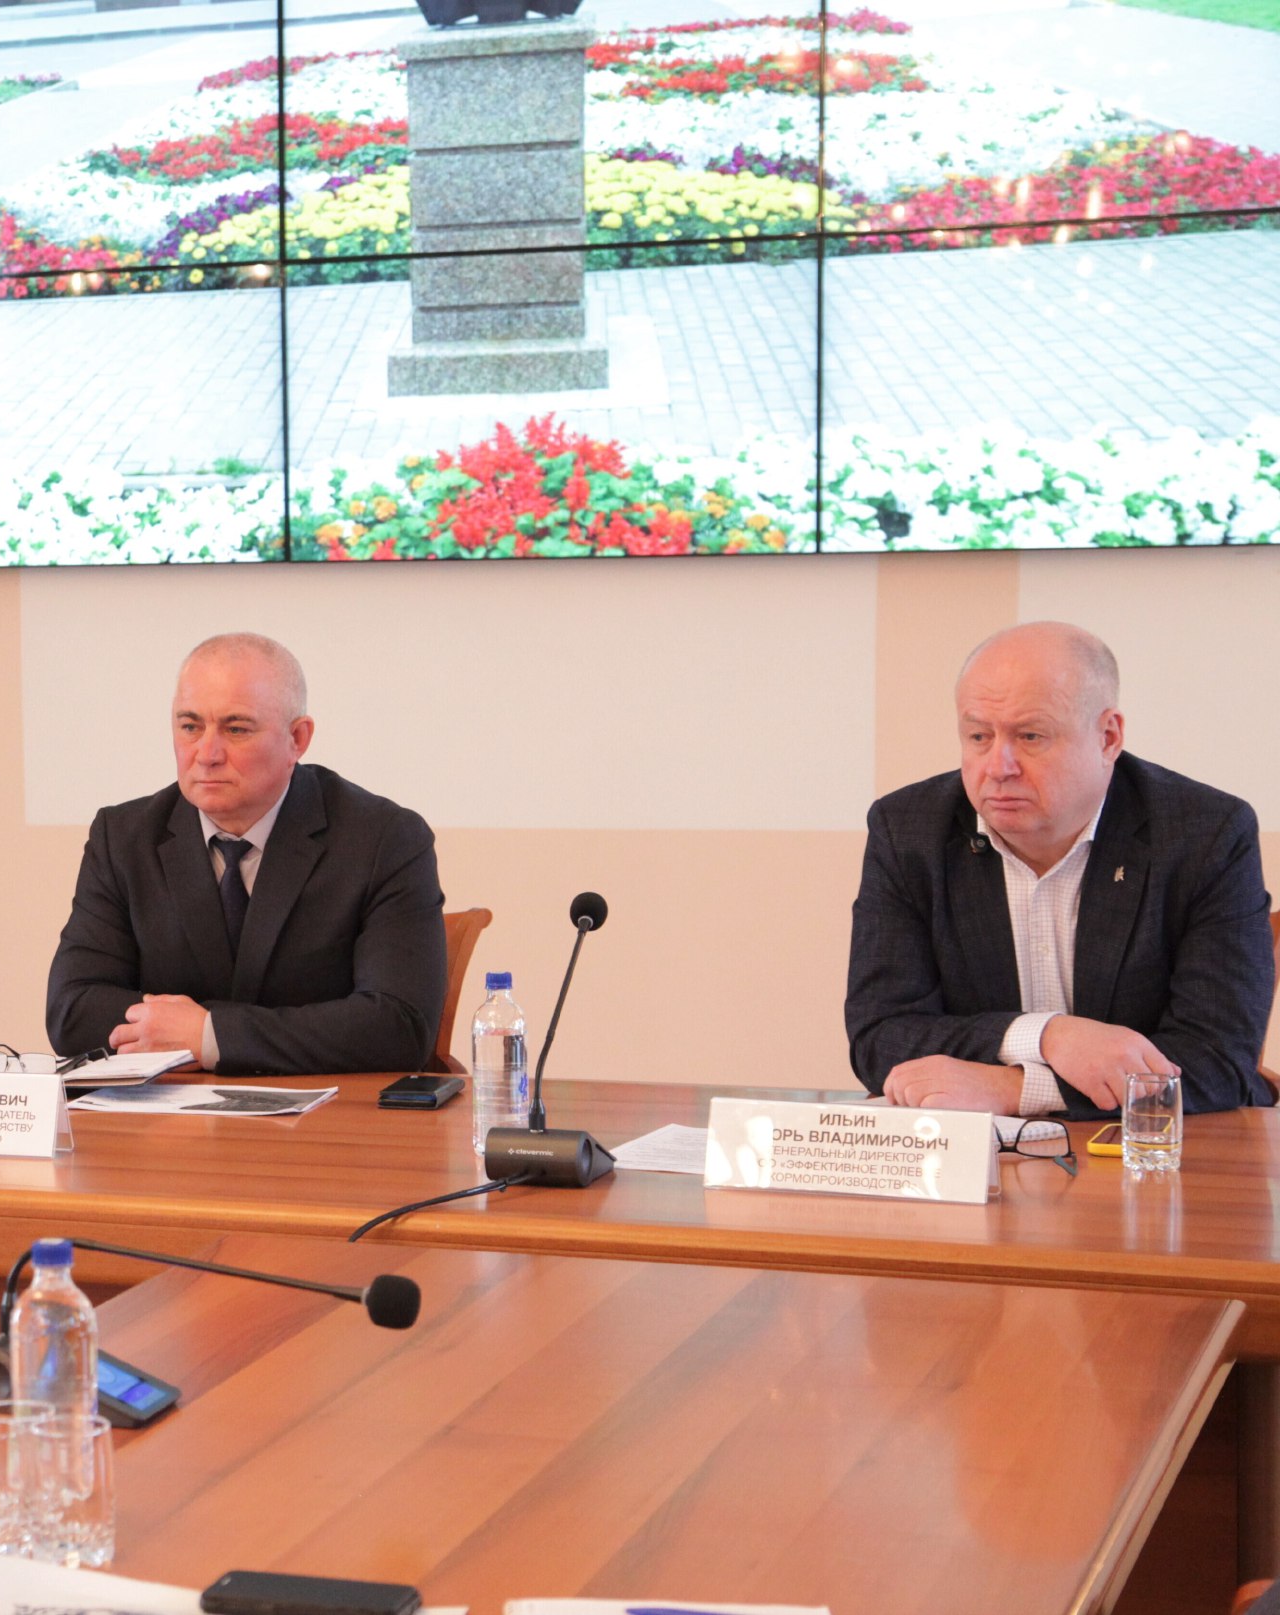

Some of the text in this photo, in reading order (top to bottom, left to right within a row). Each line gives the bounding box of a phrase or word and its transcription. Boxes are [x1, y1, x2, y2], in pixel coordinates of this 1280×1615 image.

[819, 1113, 876, 1128] ИЛЬИН
[772, 1128, 950, 1150] ОРЬ ВЛАДИМИРОВИЧ
[515, 1148, 554, 1156] clevermic
[772, 1145, 925, 1163] ЕНЕРАЛЬНЫЙ ДИРЕКТОР
